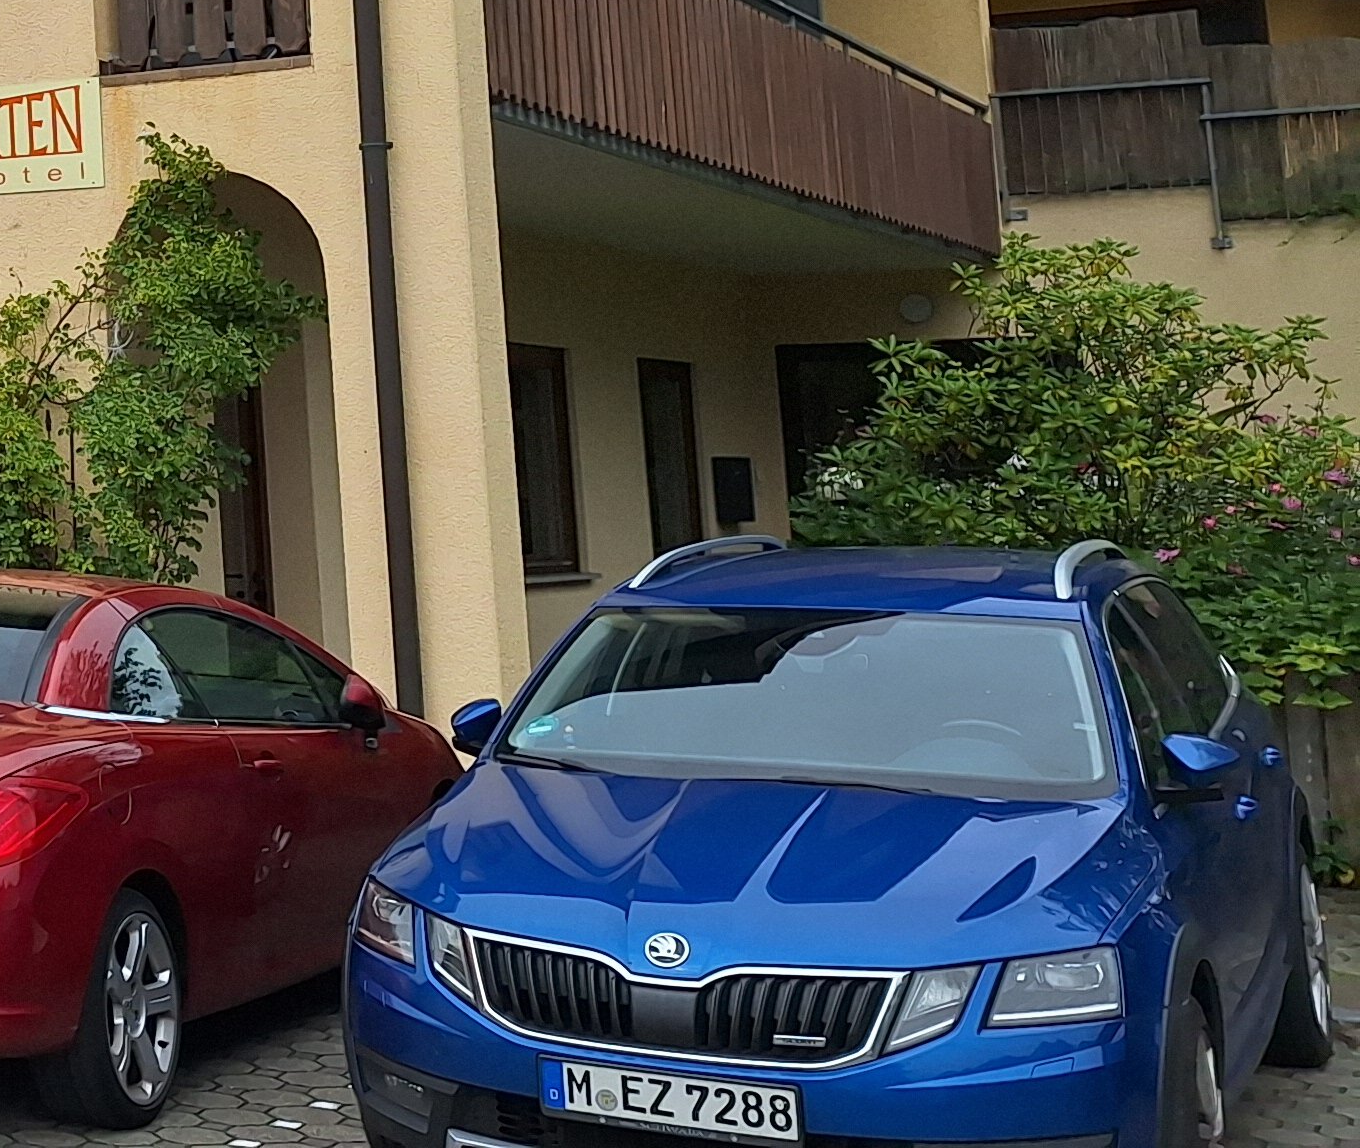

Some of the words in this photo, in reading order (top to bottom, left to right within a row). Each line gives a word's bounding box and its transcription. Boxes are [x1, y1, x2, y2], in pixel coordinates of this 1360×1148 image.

[549, 1088, 560, 1101] D
[566, 1067, 593, 1107] M
[621, 1074, 675, 1118] EZ
[685, 1083, 793, 1133] 7288
